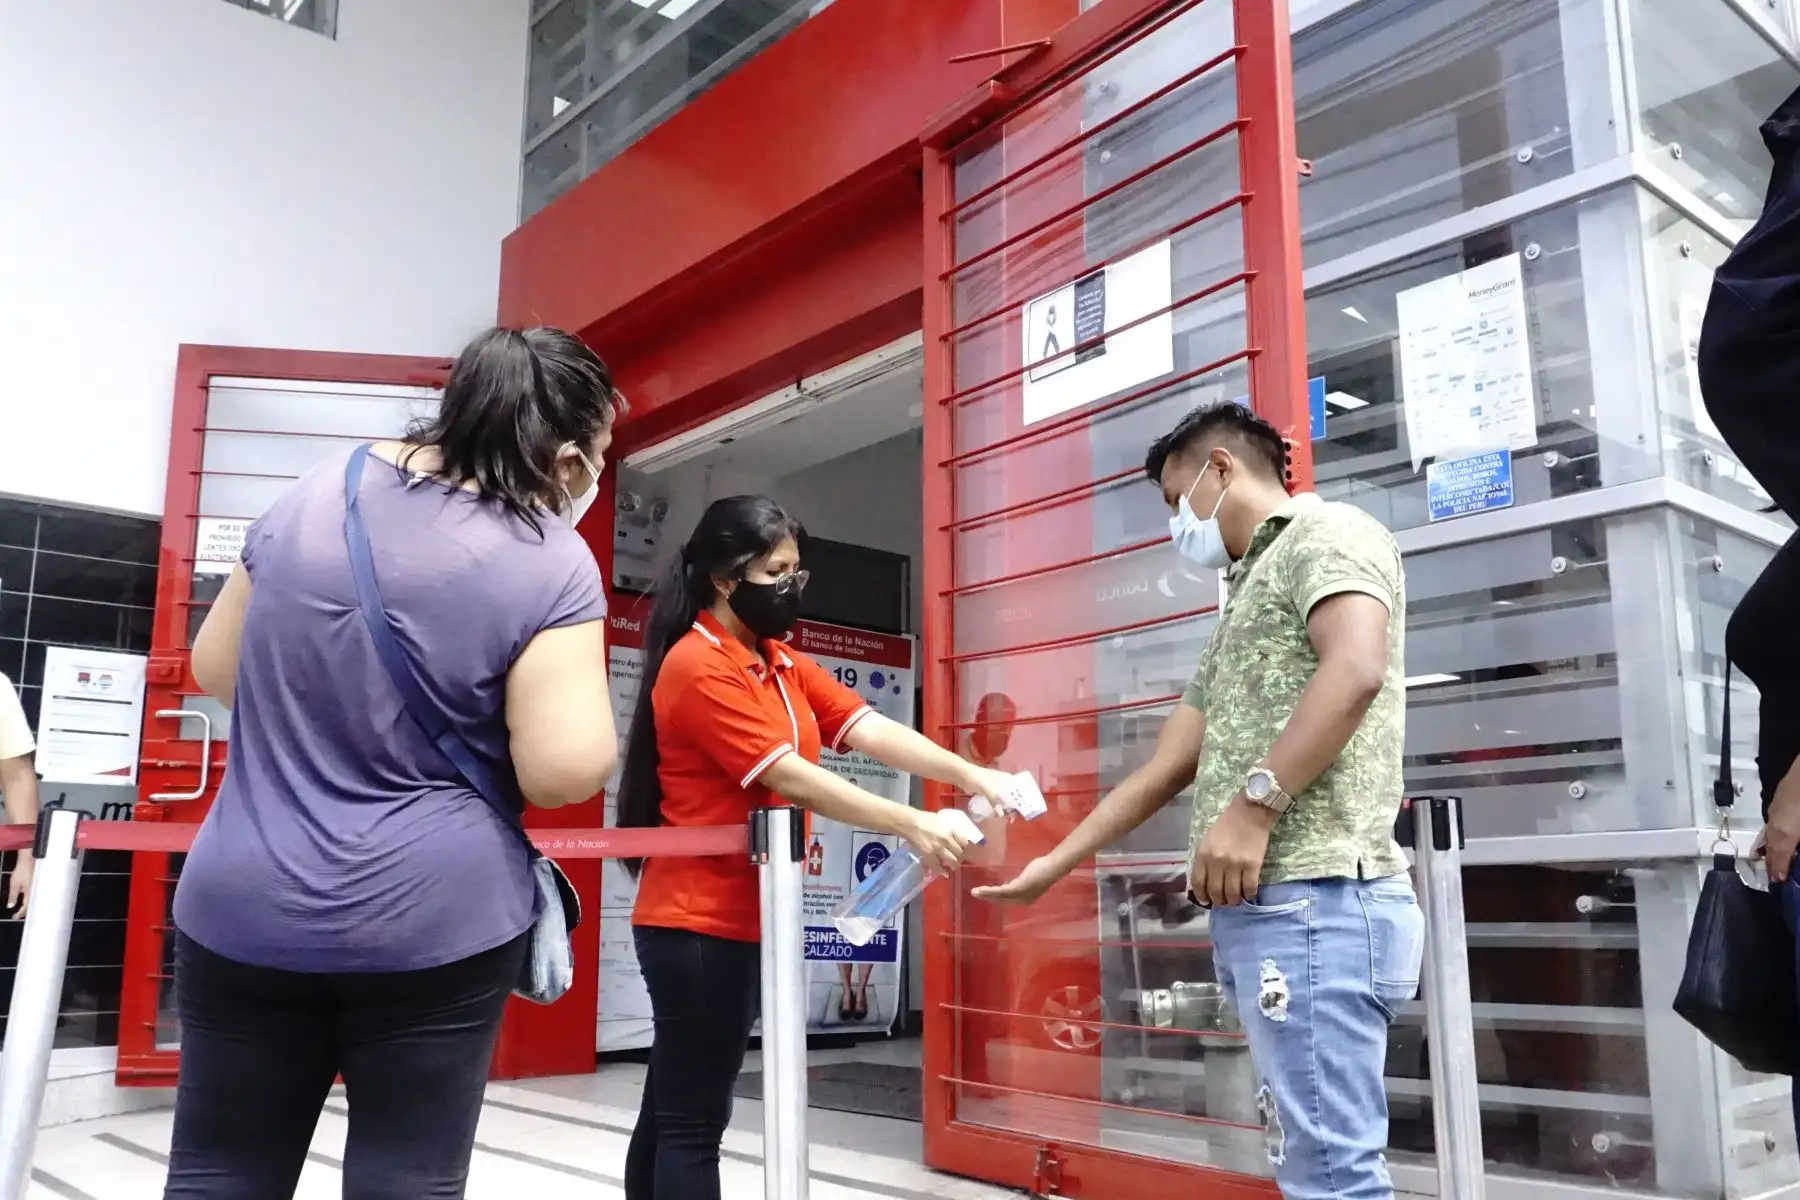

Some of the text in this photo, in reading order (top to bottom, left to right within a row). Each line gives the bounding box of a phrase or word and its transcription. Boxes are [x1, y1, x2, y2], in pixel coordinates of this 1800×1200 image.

[1468, 278, 1516, 300] MoneyGram
[1453, 457, 1482, 469] OFICINA
[1474, 460, 1504, 472] CONTRA
[1432, 501, 1442, 509] LA
[1472, 489, 1509, 502] NACIONAL
[219, 524, 231, 532] POR
[209, 534, 242, 542] PROHIBIDO
[200, 553, 237, 561] ELECTRONIC
[610, 615, 641, 632] ltiRed
[801, 627, 884, 650] Banco de la Nación
[811, 640, 833, 650] banco
[834, 644, 843, 652] de
[845, 645, 865, 656] todos
[609, 656, 626, 666] estro
[833, 666, 858, 689] 19
[819, 754, 850, 763] TROLANDO
[818, 763, 838, 773] NCIA
[840, 765, 851, 774] DE
[553, 839, 564, 849] de
[566, 839, 575, 849] la
[804, 931, 887, 946] ESINFENTE
[804, 944, 853, 957] CALZADO
